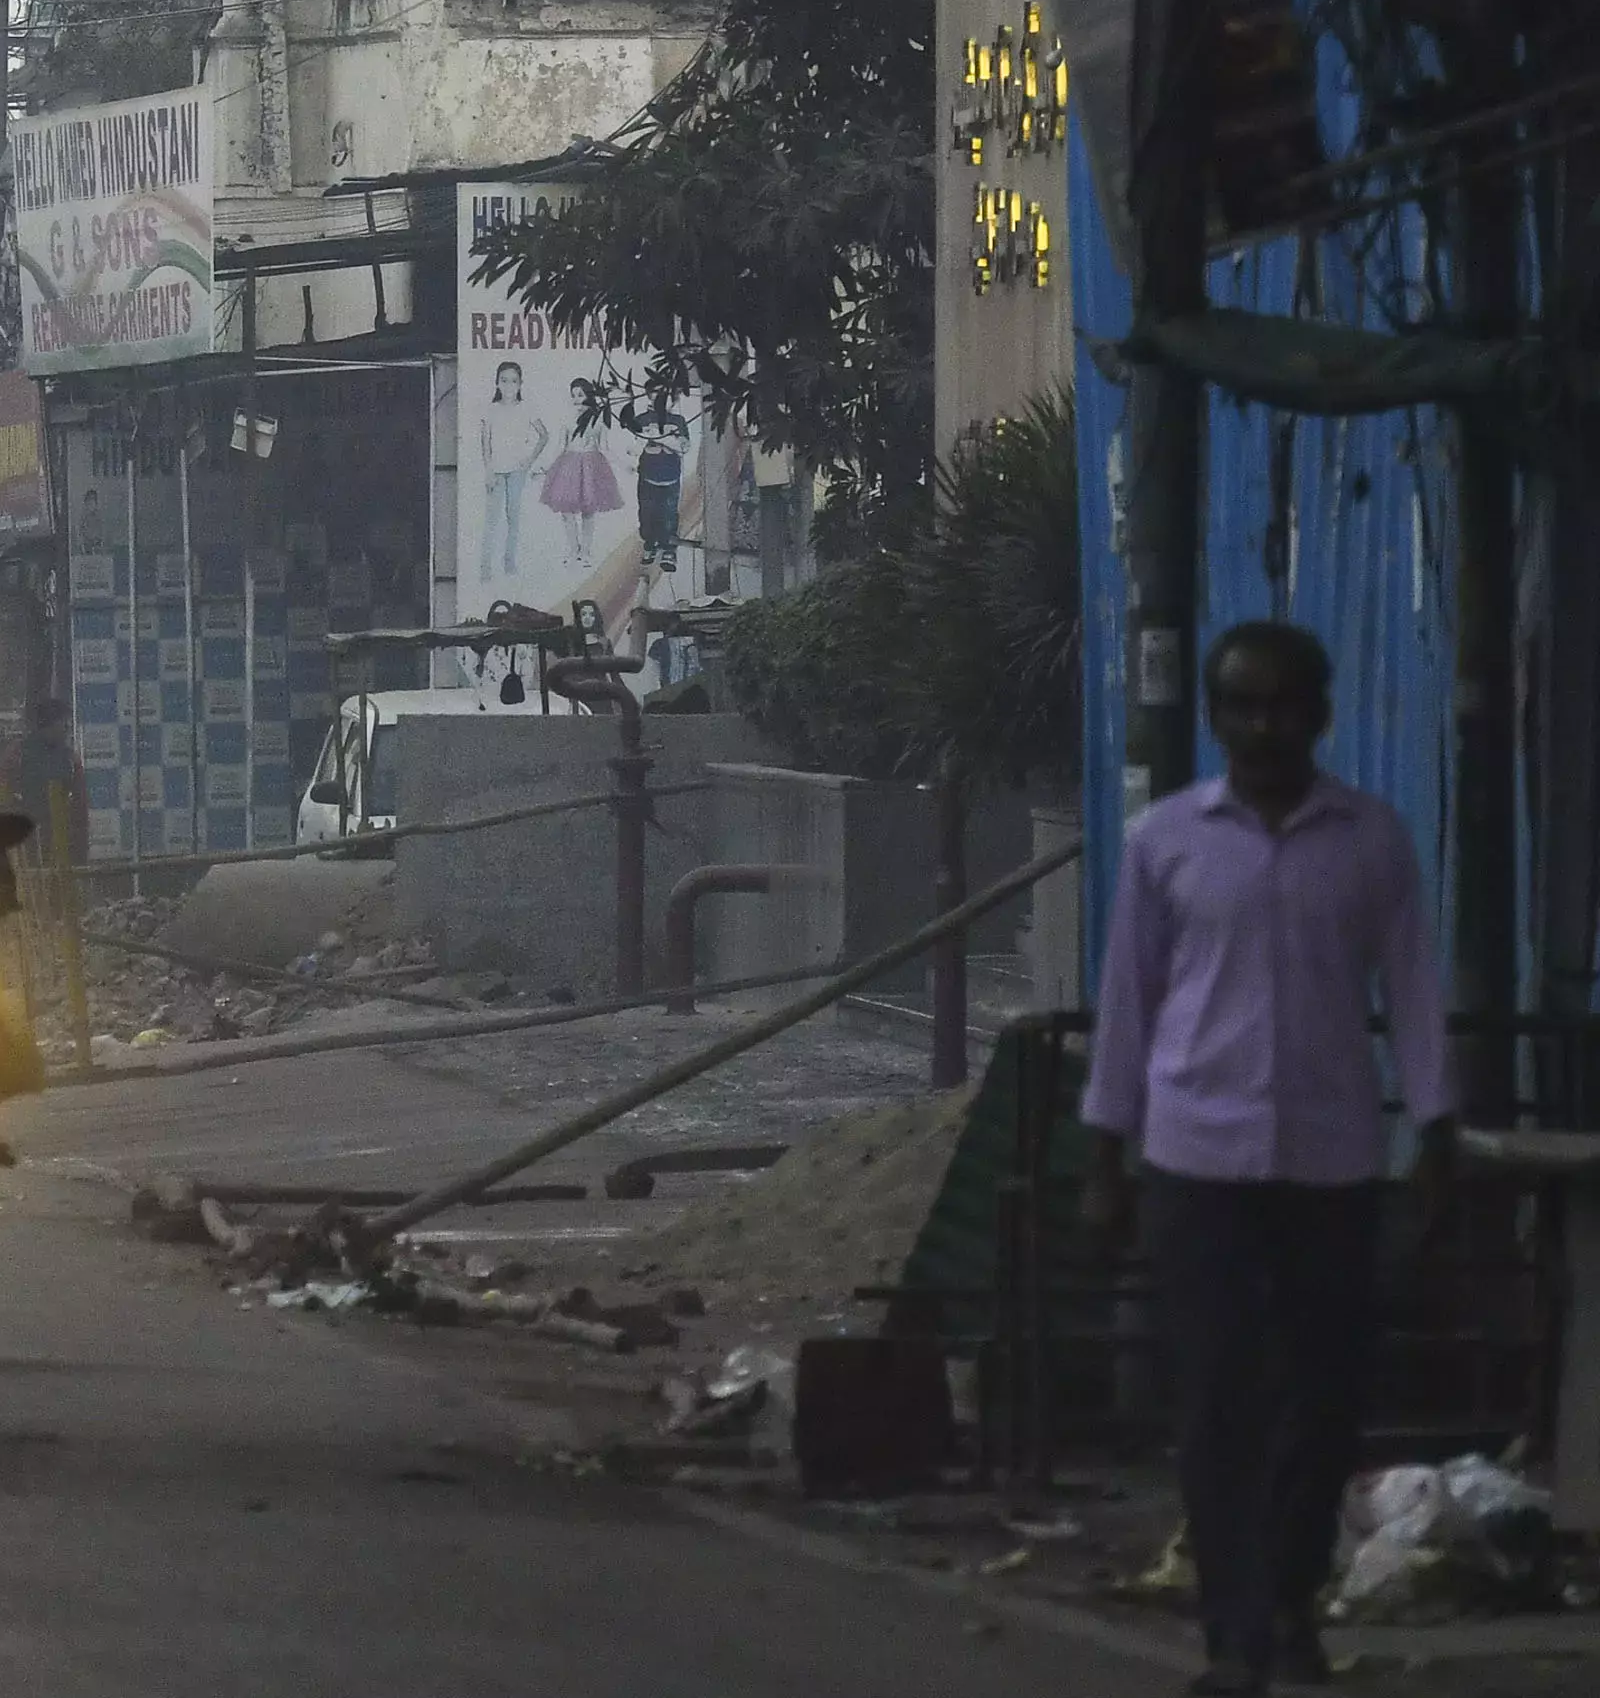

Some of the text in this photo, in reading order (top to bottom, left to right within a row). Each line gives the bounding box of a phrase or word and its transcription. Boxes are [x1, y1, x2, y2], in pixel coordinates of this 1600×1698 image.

[97, 100, 200, 199] HINDUSTANI
[91, 206, 160, 276] SONS
[107, 280, 193, 344] GARMENTS
